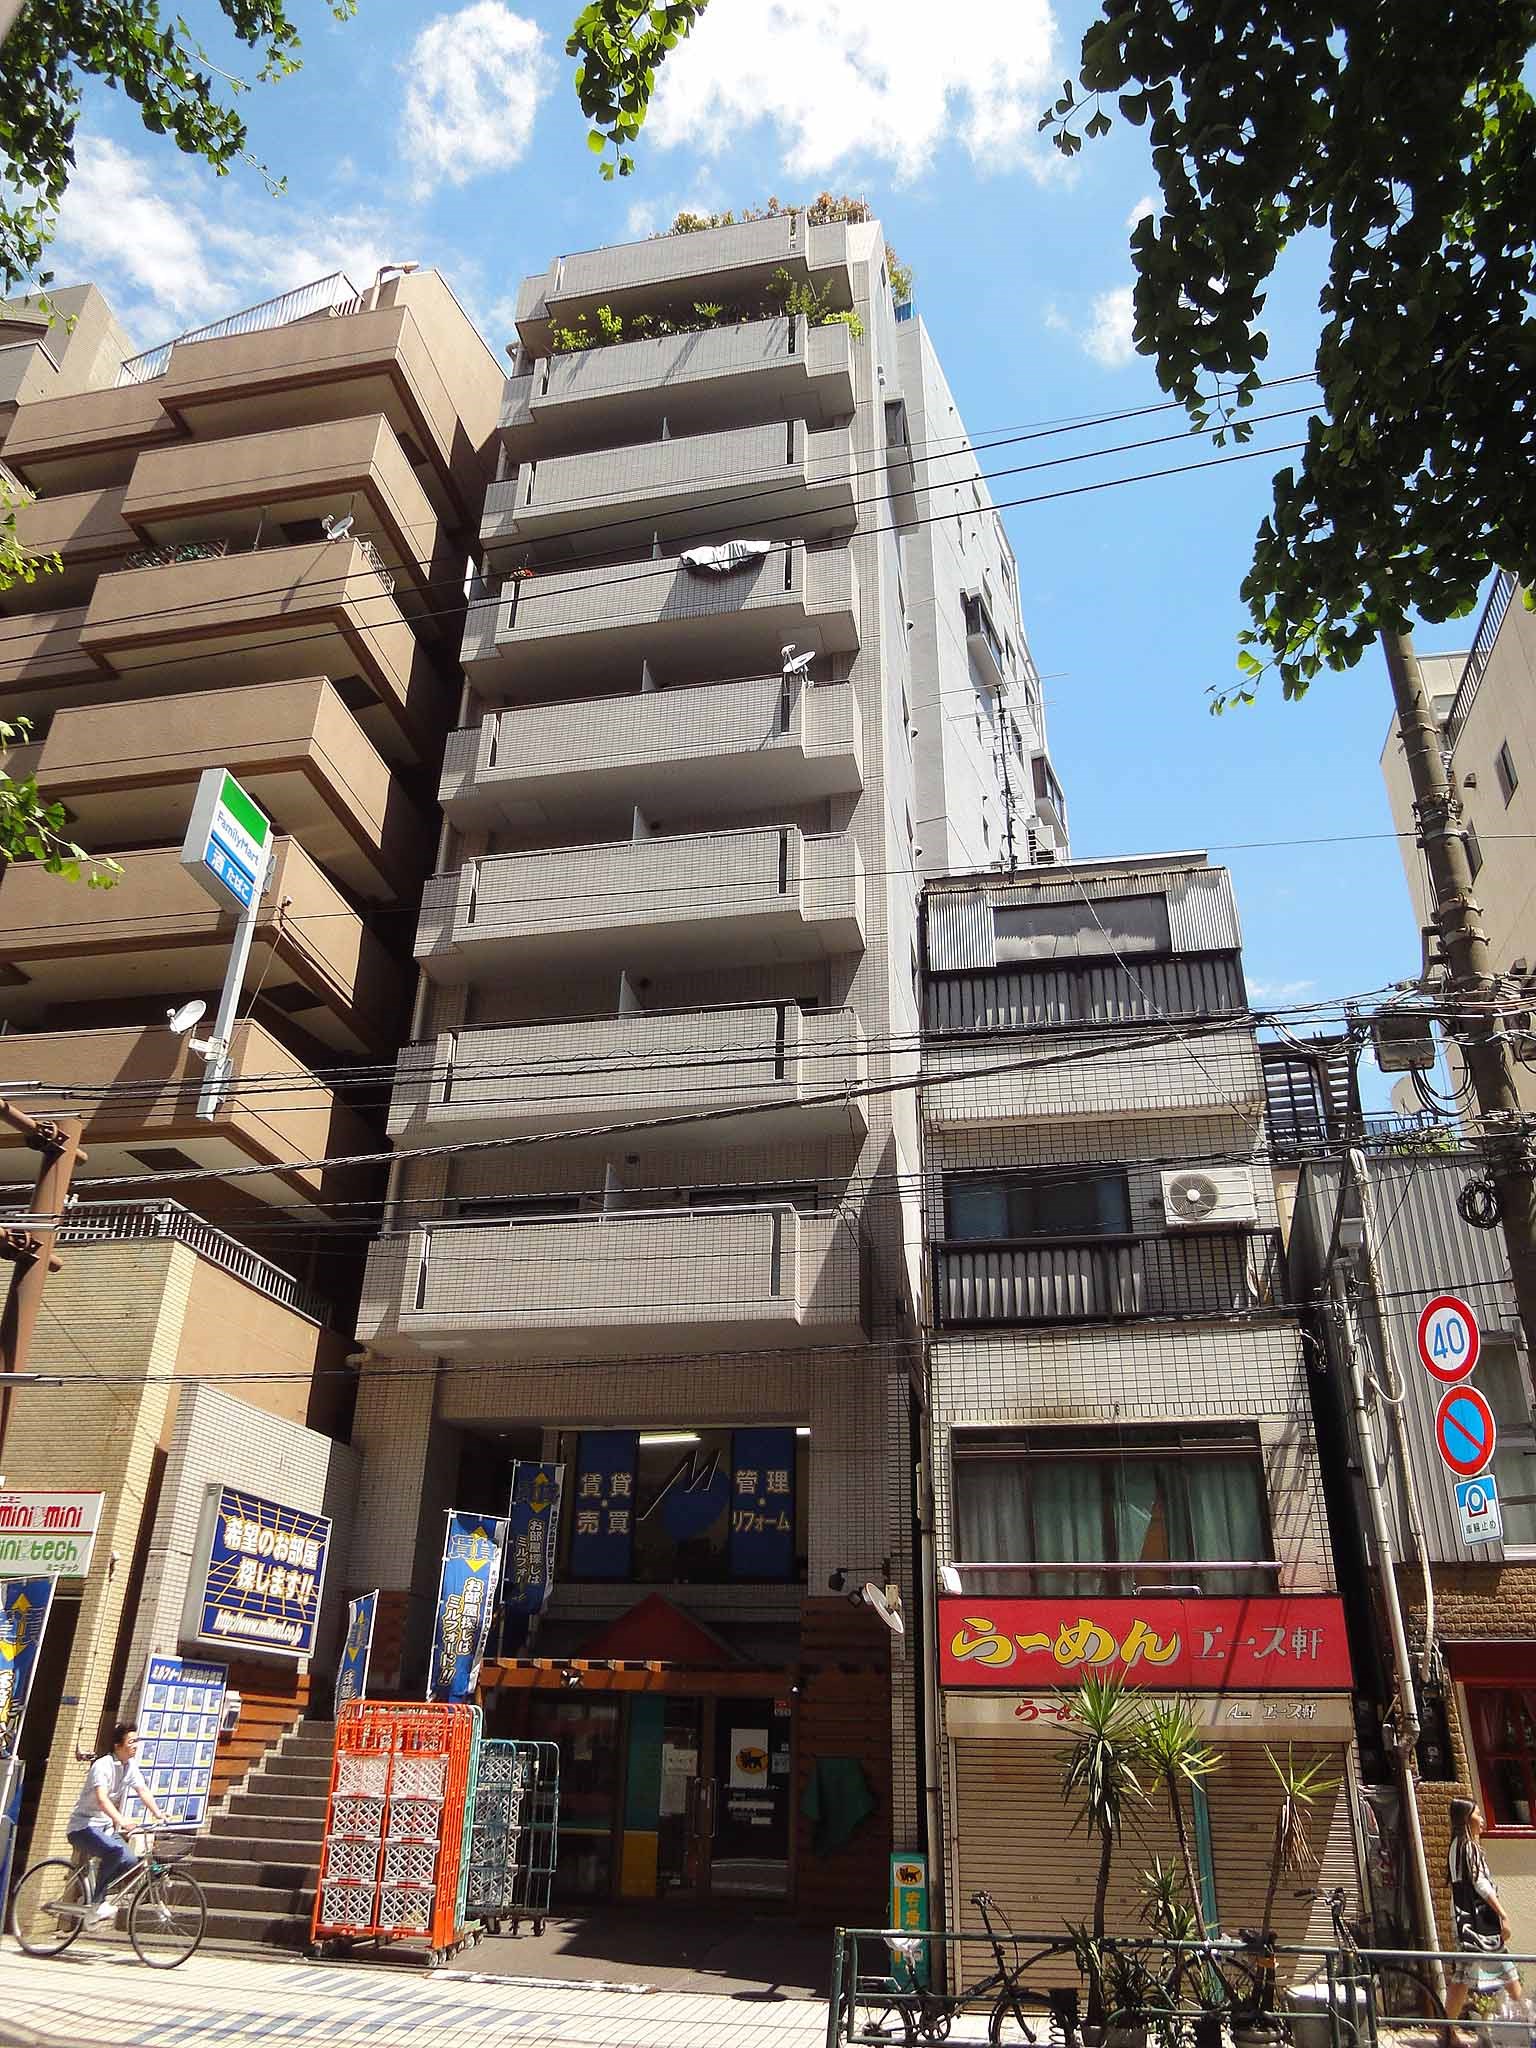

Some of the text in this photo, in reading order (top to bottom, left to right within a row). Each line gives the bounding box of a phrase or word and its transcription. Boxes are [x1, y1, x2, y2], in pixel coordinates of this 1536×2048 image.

[216, 810, 259, 866] FamilyMart
[226, 867, 250, 900] たばこ
[1433, 1317, 1465, 1358] 40
[735, 1470, 790, 1494] 管理
[44, 1506, 83, 1527] mini
[577, 1510, 630, 1535] 売買
[732, 1511, 791, 1532] リフォーム
[31, 1540, 77, 1560] tech
[224, 1515, 321, 1570] 希望のお部屋
[458, 1576, 484, 1655] お部屋探しは
[951, 1616, 1325, 1667] らーめん エース軒
